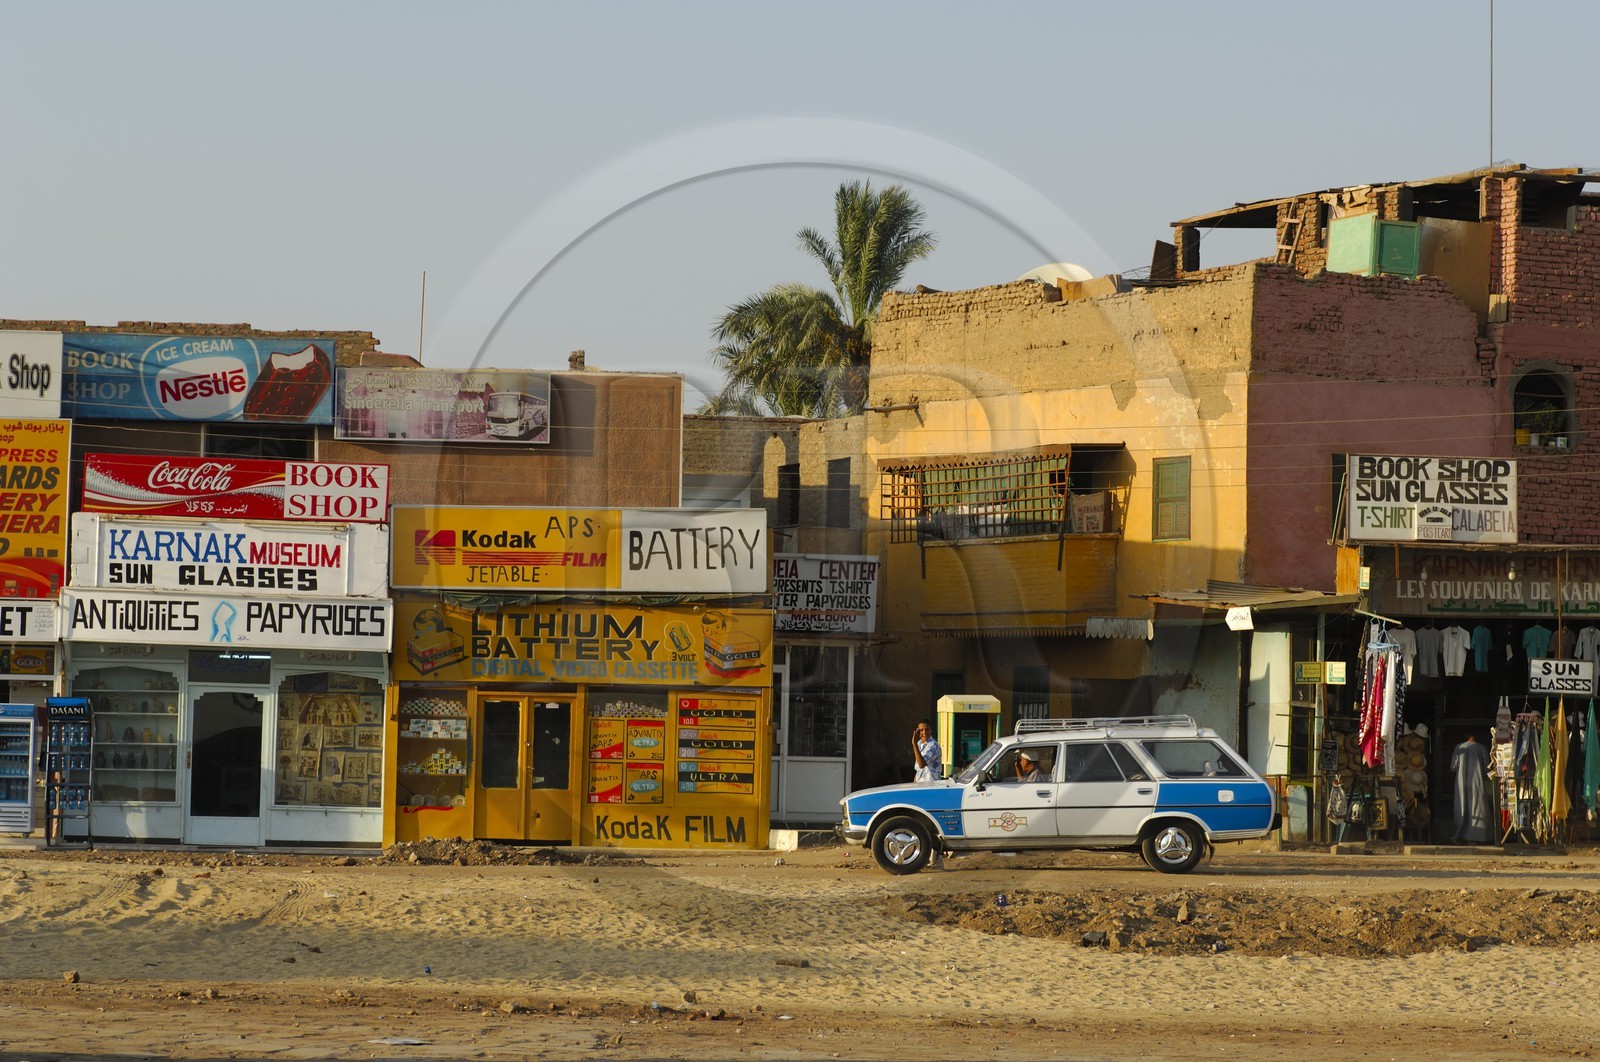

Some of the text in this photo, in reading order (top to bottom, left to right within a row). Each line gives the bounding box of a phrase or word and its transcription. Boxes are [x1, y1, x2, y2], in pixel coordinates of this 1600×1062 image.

[67, 350, 135, 370] BOOK
[155, 339, 235, 363] ICE CREAM
[8, 353, 51, 397] Shop
[68, 381, 131, 399] SHOP
[344, 396, 485, 414] Sinderella Transport
[147, 460, 237, 491] Coca-Cola
[290, 465, 380, 489] BOOK
[1358, 456, 1511, 482] BOOK SHOP
[1356, 480, 1509, 505] SUN GLASSES
[288, 494, 379, 518] SHOP
[544, 516, 594, 539] APS
[1357, 506, 1416, 529] T-SHIRT
[108, 529, 341, 568] KARNAK MUSEUM
[462, 529, 537, 549] Kodak
[629, 526, 761, 572] BATTERY
[561, 553, 608, 568] FILM
[1412, 554, 1512, 577] KARNAK
[109, 563, 319, 591] SUN GLASSES
[466, 566, 541, 583] JETABLE
[819, 561, 877, 581] CENTER
[1396, 580, 1427, 599] LES
[1429, 580, 1523, 600] SOUVENIRS
[1530, 582, 1551, 600] DE
[806, 594, 871, 610] PAPYRUSES
[246, 602, 385, 637] PAPYRUSES
[471, 612, 644, 639] LITHIUM
[471, 637, 660, 662] BATTERY
[671, 652, 697, 662] 3 VOLT
[725, 652, 758, 660] GOLD
[17, 659, 42, 667] GOLD
[471, 657, 546, 678] DIGITAL
[614, 660, 699, 681] CASSETTE
[1541, 662, 1580, 676] SUN
[1530, 678, 1592, 693] GLASSES
[50, 707, 84, 715] DASANI
[598, 739, 612, 747] APS
[628, 729, 663, 738] ADVANTIX
[633, 739, 655, 747] ULTRA
[640, 770, 658, 780] APS
[690, 772, 739, 781] ULTRA
[633, 783, 656, 791] ULTRA
[685, 816, 746, 843] FILM
